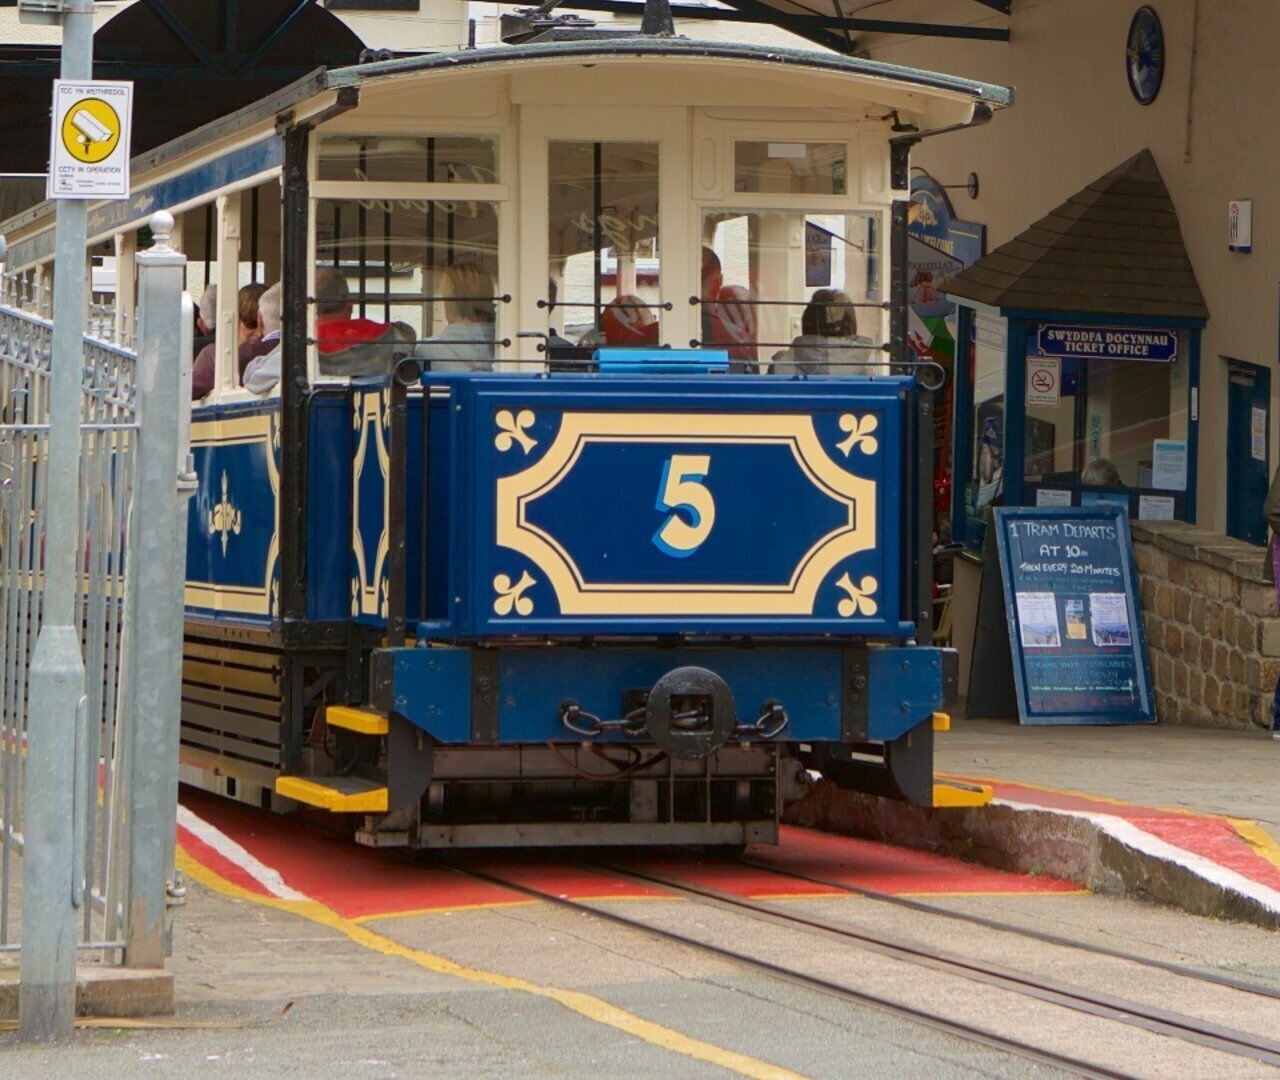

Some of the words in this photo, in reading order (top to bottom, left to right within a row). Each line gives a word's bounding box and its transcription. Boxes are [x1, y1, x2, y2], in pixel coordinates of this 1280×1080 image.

[60, 87, 72, 95] TCC
[86, 88, 125, 96] WEITHREDOL
[1047, 330, 1101, 342] SWYDDFA
[1106, 331, 1168, 346] DOCYNNAU
[1064, 342, 1104, 354] TICKET
[1108, 343, 1148, 355] OFFICE
[652, 454, 716, 558] 5
[1023, 522, 1060, 537] TRAM
[1063, 522, 1116, 540] DEPARTS
[1039, 544, 1061, 556] AT
[1042, 563, 1068, 575] EVERY
[1071, 563, 1083, 574] 20
[1084, 563, 1120, 577] MINUTES
